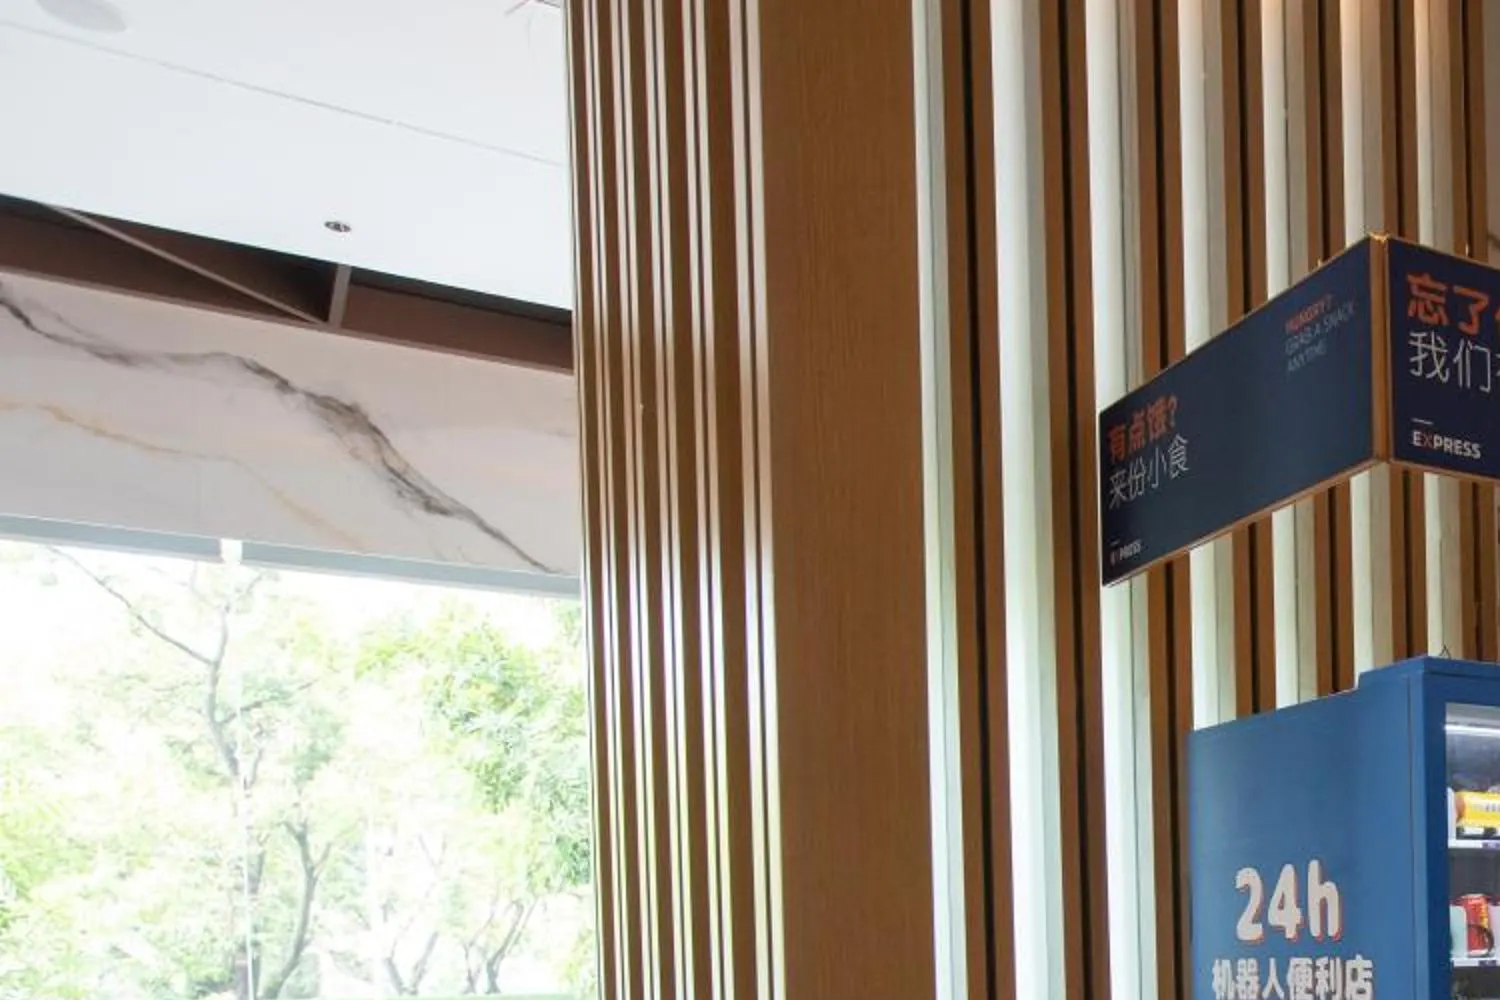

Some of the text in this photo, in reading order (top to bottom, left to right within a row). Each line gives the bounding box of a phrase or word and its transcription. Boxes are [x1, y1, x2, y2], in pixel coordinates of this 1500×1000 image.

[1108, 433, 1189, 509] 来份小食
[1412, 430, 1481, 460] EXPRESS
[1235, 859, 1343, 943] 24h
